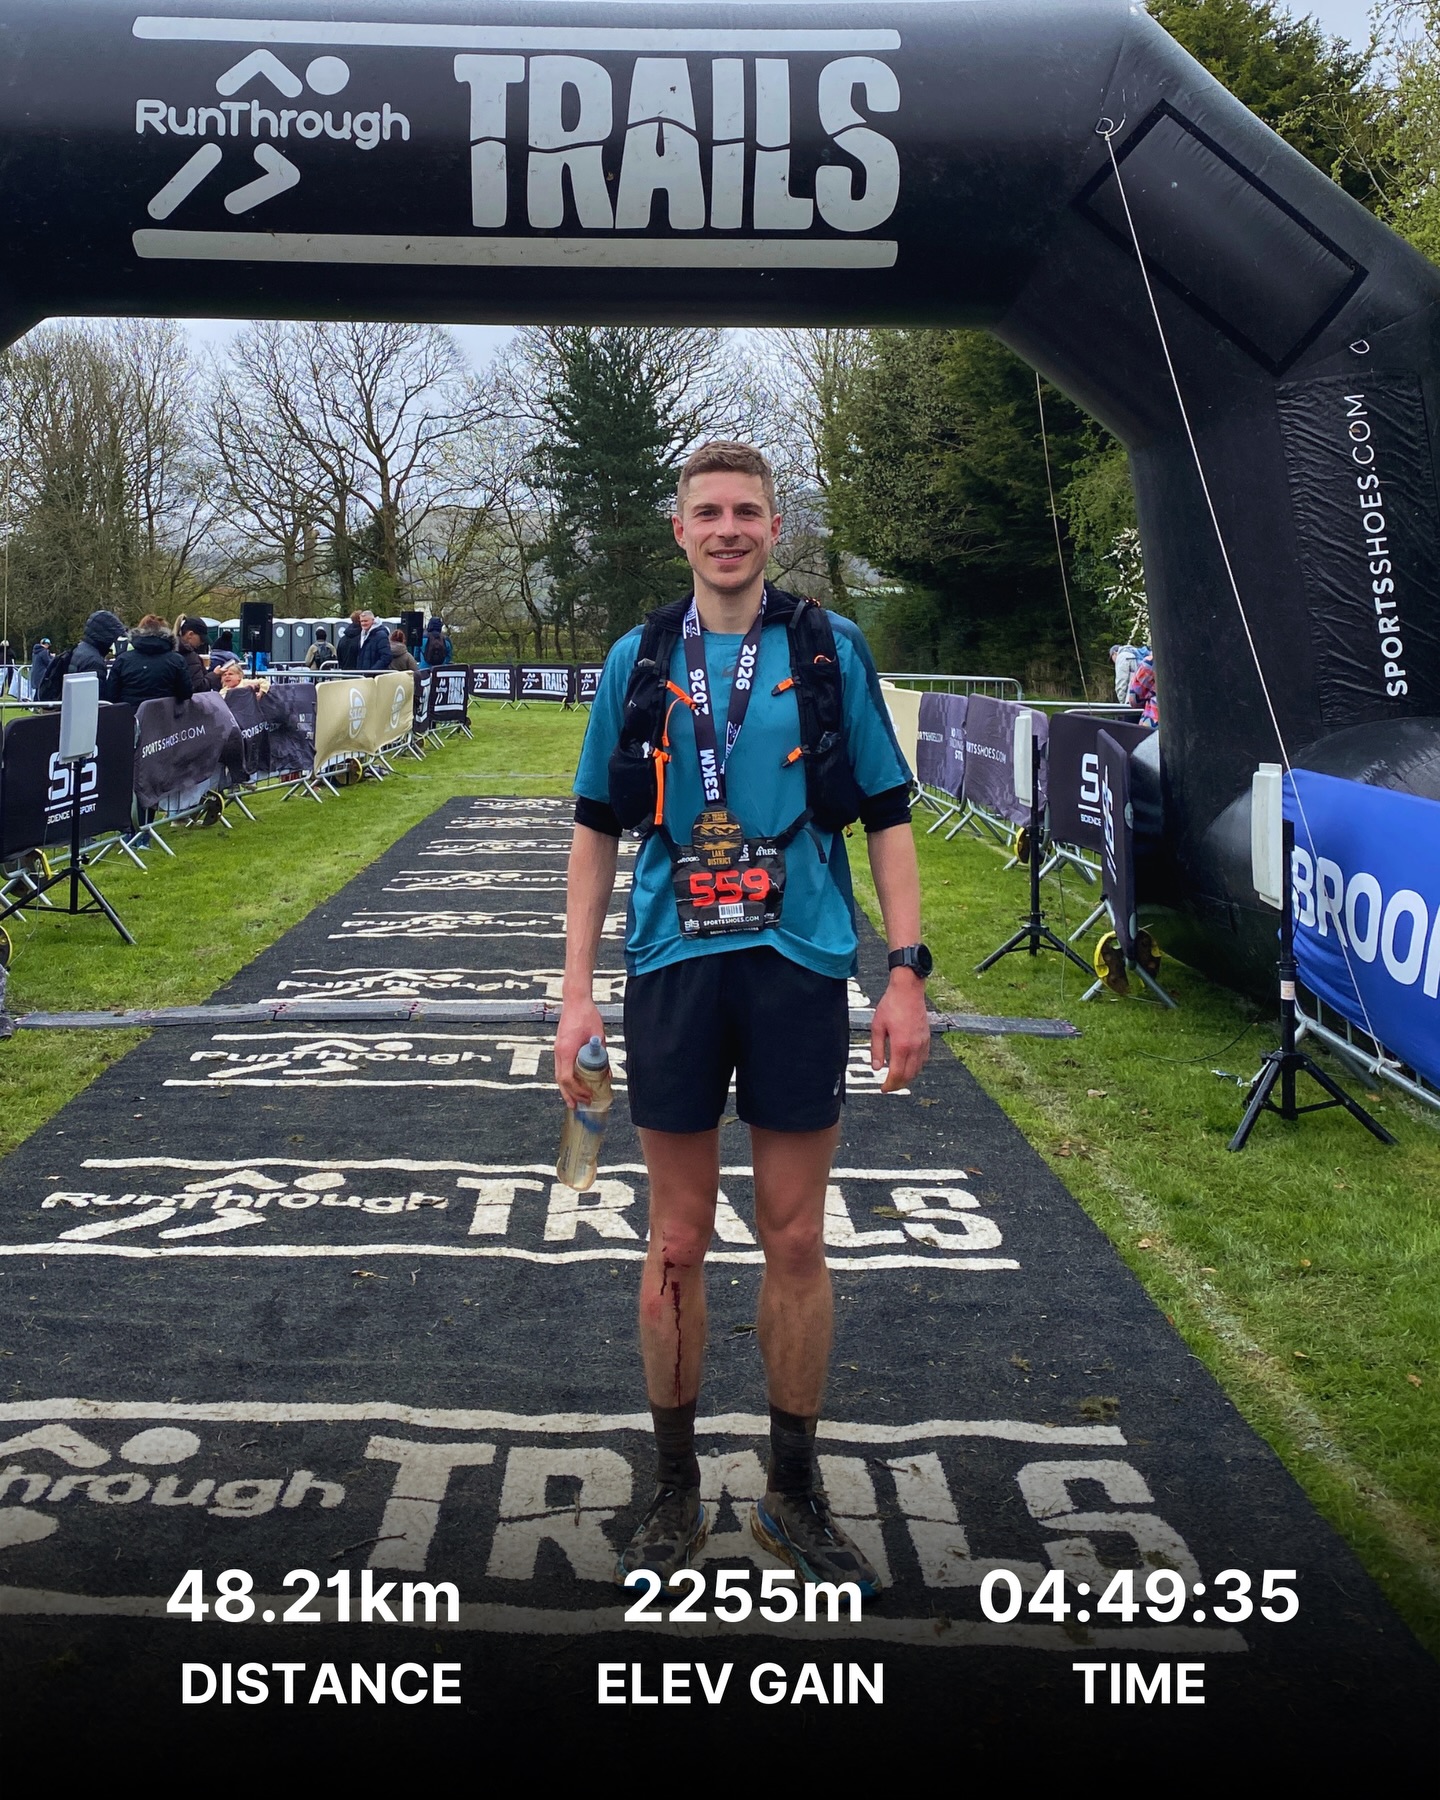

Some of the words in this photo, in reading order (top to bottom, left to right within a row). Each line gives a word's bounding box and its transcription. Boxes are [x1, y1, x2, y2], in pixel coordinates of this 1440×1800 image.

[135, 99, 411, 151] RunThrough
[453, 53, 902, 233] TRAILS
[1344, 394, 1408, 696] SPORTSSHOES.COM
[541, 672, 569, 692] TRAILS
[736, 644, 757, 691] 2026
[700, 748, 721, 801] 53KM
[707, 857, 732, 866] DISTRICT
[712, 849, 726, 858] LAKE
[689, 868, 771, 908] 559
[40, 1189, 449, 1215] RunThrough
[0, 1465, 346, 1517] hrough
